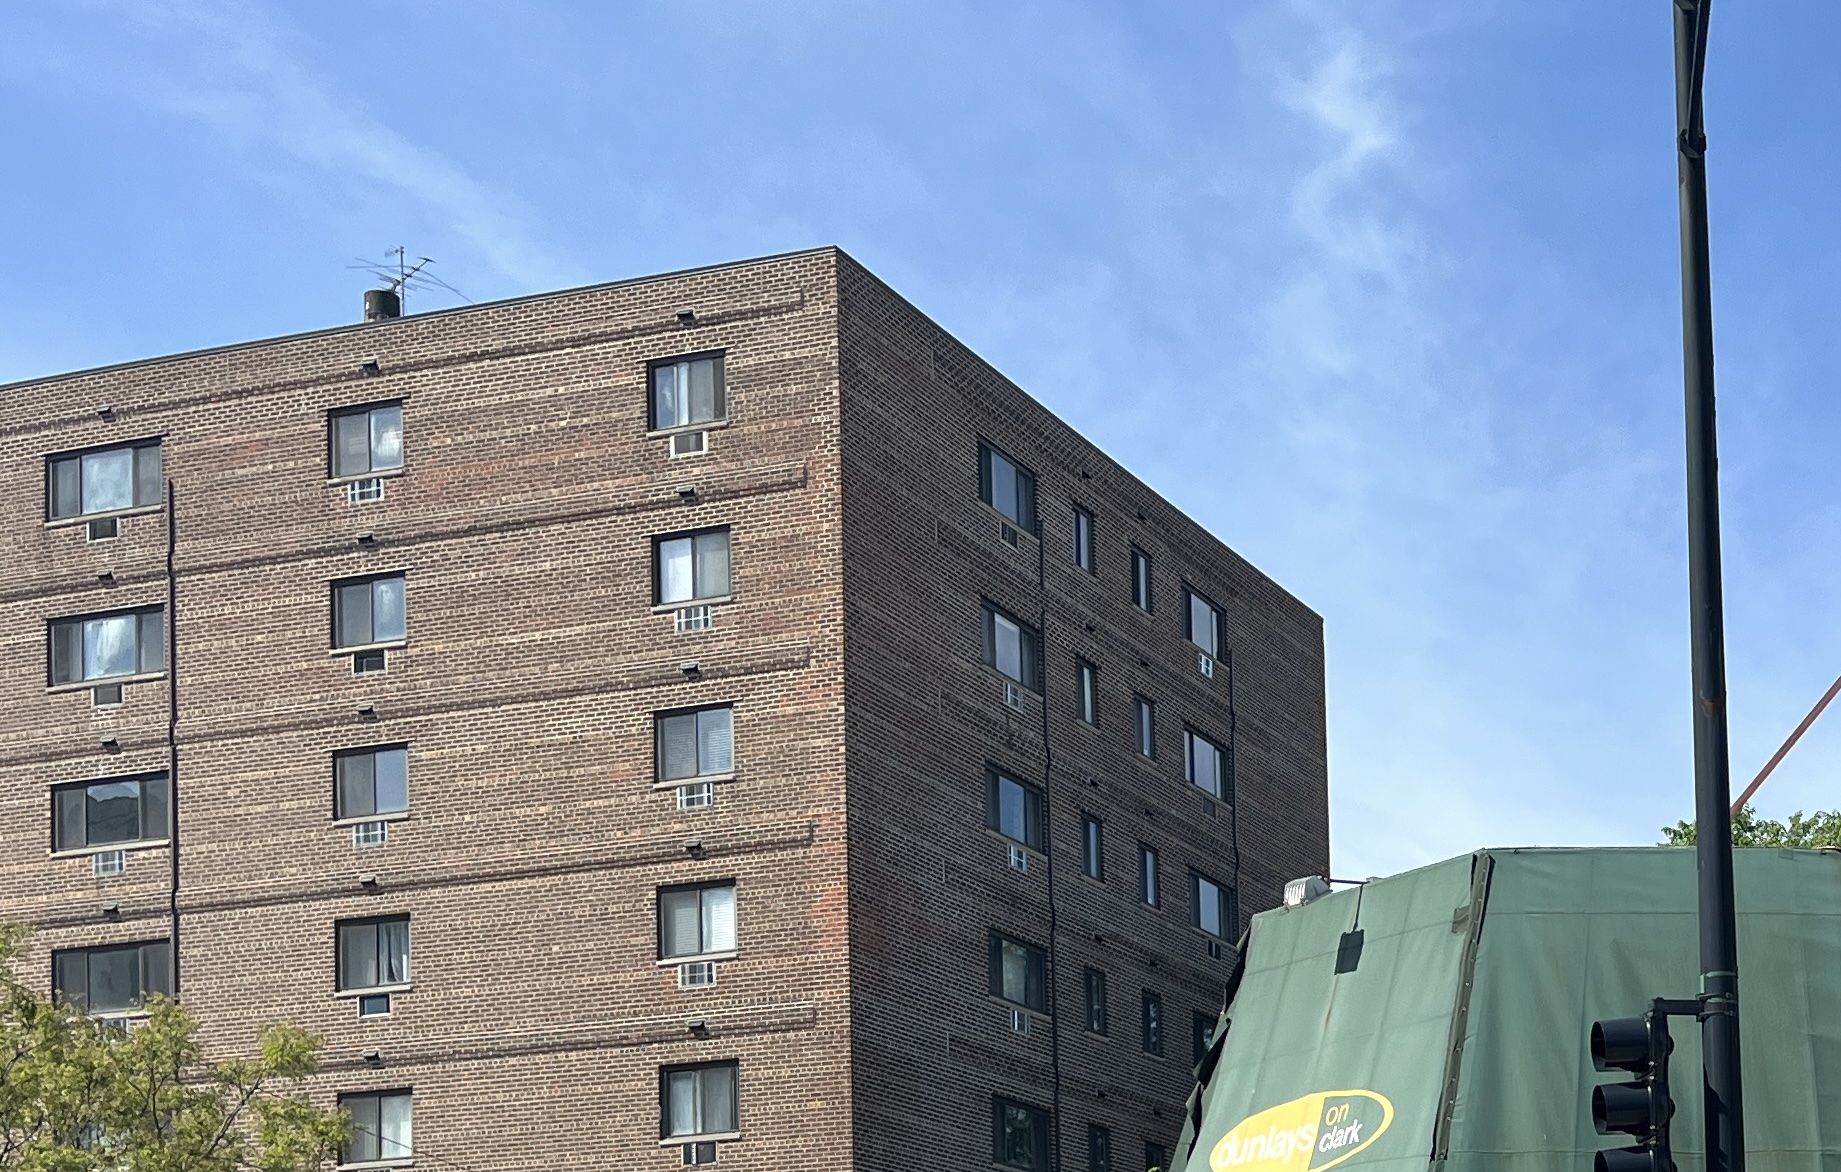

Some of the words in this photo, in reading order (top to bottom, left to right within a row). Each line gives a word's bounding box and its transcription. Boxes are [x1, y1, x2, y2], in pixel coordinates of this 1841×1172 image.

[1325, 1103, 1350, 1126] on
[1216, 1122, 1317, 1169] dunlays
[1319, 1119, 1363, 1153] clark
